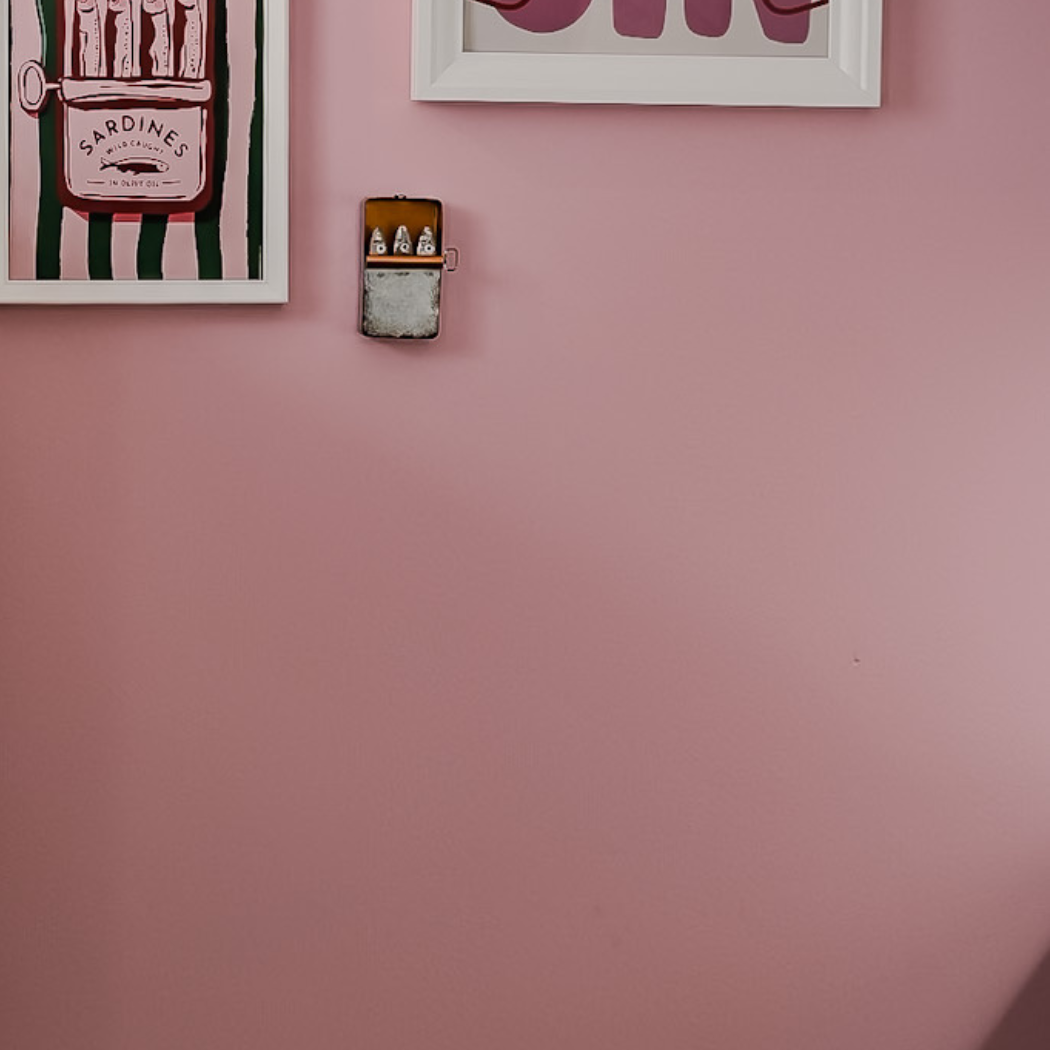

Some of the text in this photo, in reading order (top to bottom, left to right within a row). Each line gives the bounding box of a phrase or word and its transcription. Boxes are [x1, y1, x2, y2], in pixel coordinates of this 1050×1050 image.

[79, 115, 189, 158] SARDINES
[106, 139, 164, 155] WILD CAUGHT
